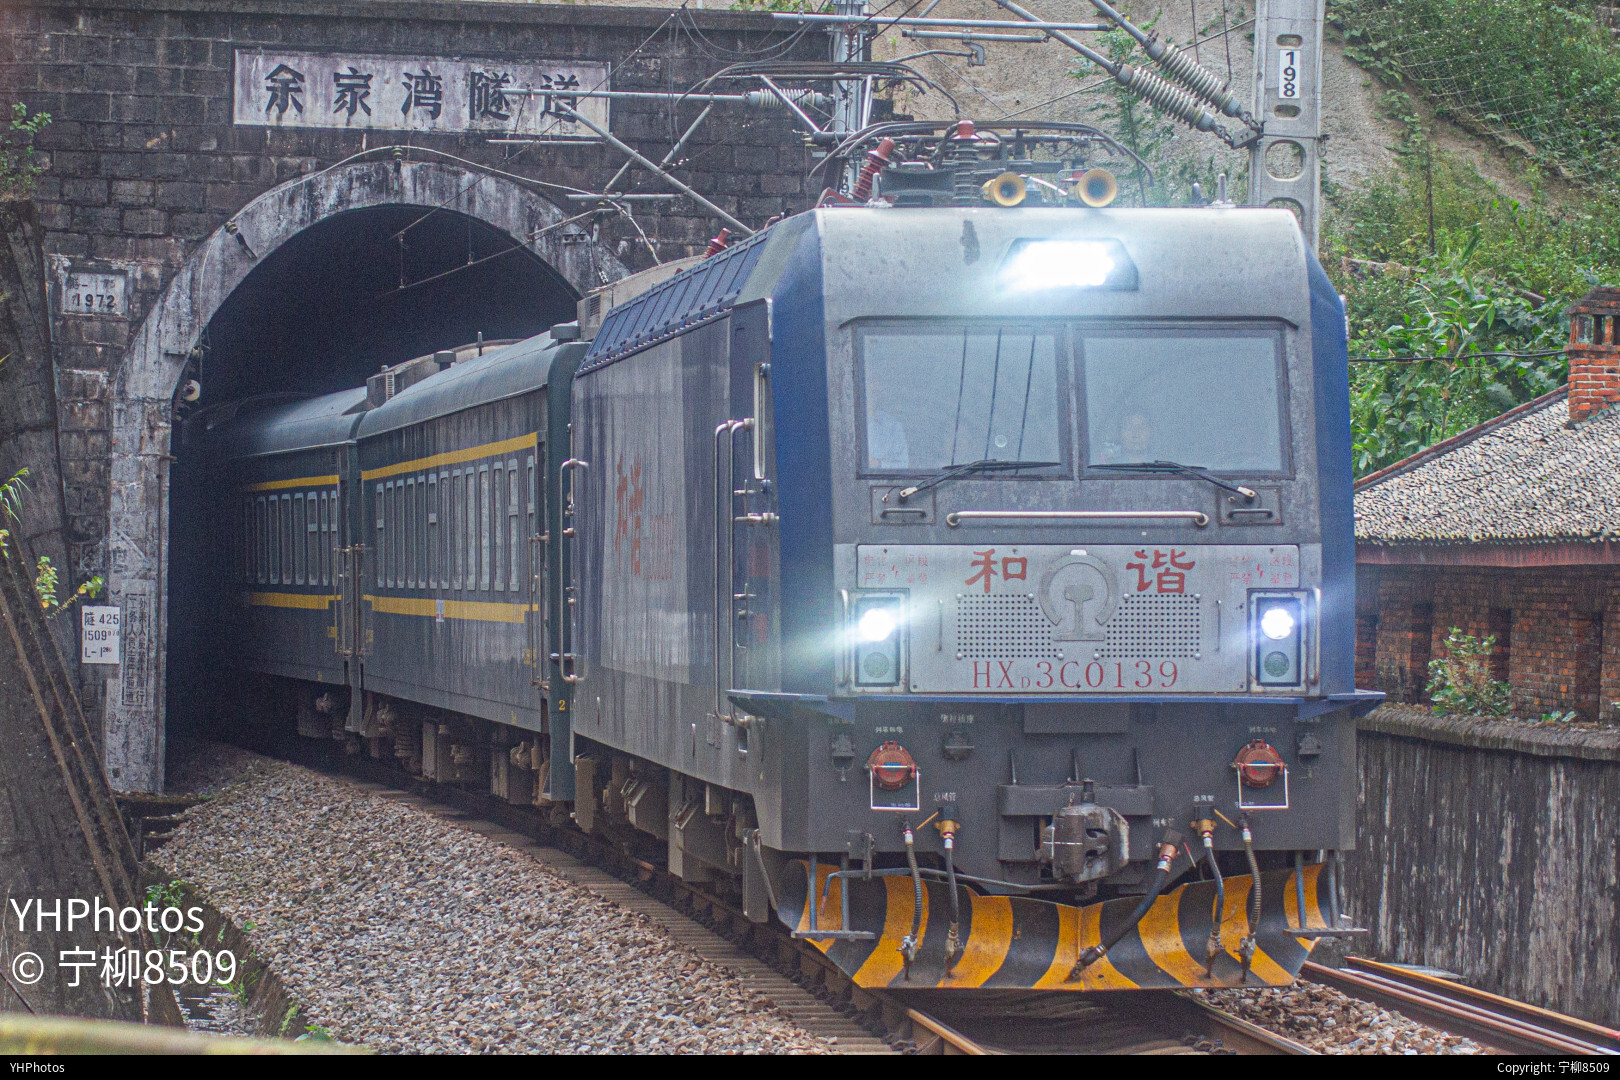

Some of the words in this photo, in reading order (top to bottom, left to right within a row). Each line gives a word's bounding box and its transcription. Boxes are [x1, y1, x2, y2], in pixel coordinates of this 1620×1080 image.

[1283, 51, 1296, 97] 198
[264, 63, 580, 123] 余家湾隧道
[72, 293, 116, 308] 1972
[965, 548, 1028, 593] 和
[1126, 549, 1196, 594] 谐
[99, 614, 119, 625] 425
[971, 660, 1179, 689] HXD3C0139
[558, 699, 567, 711] 2
